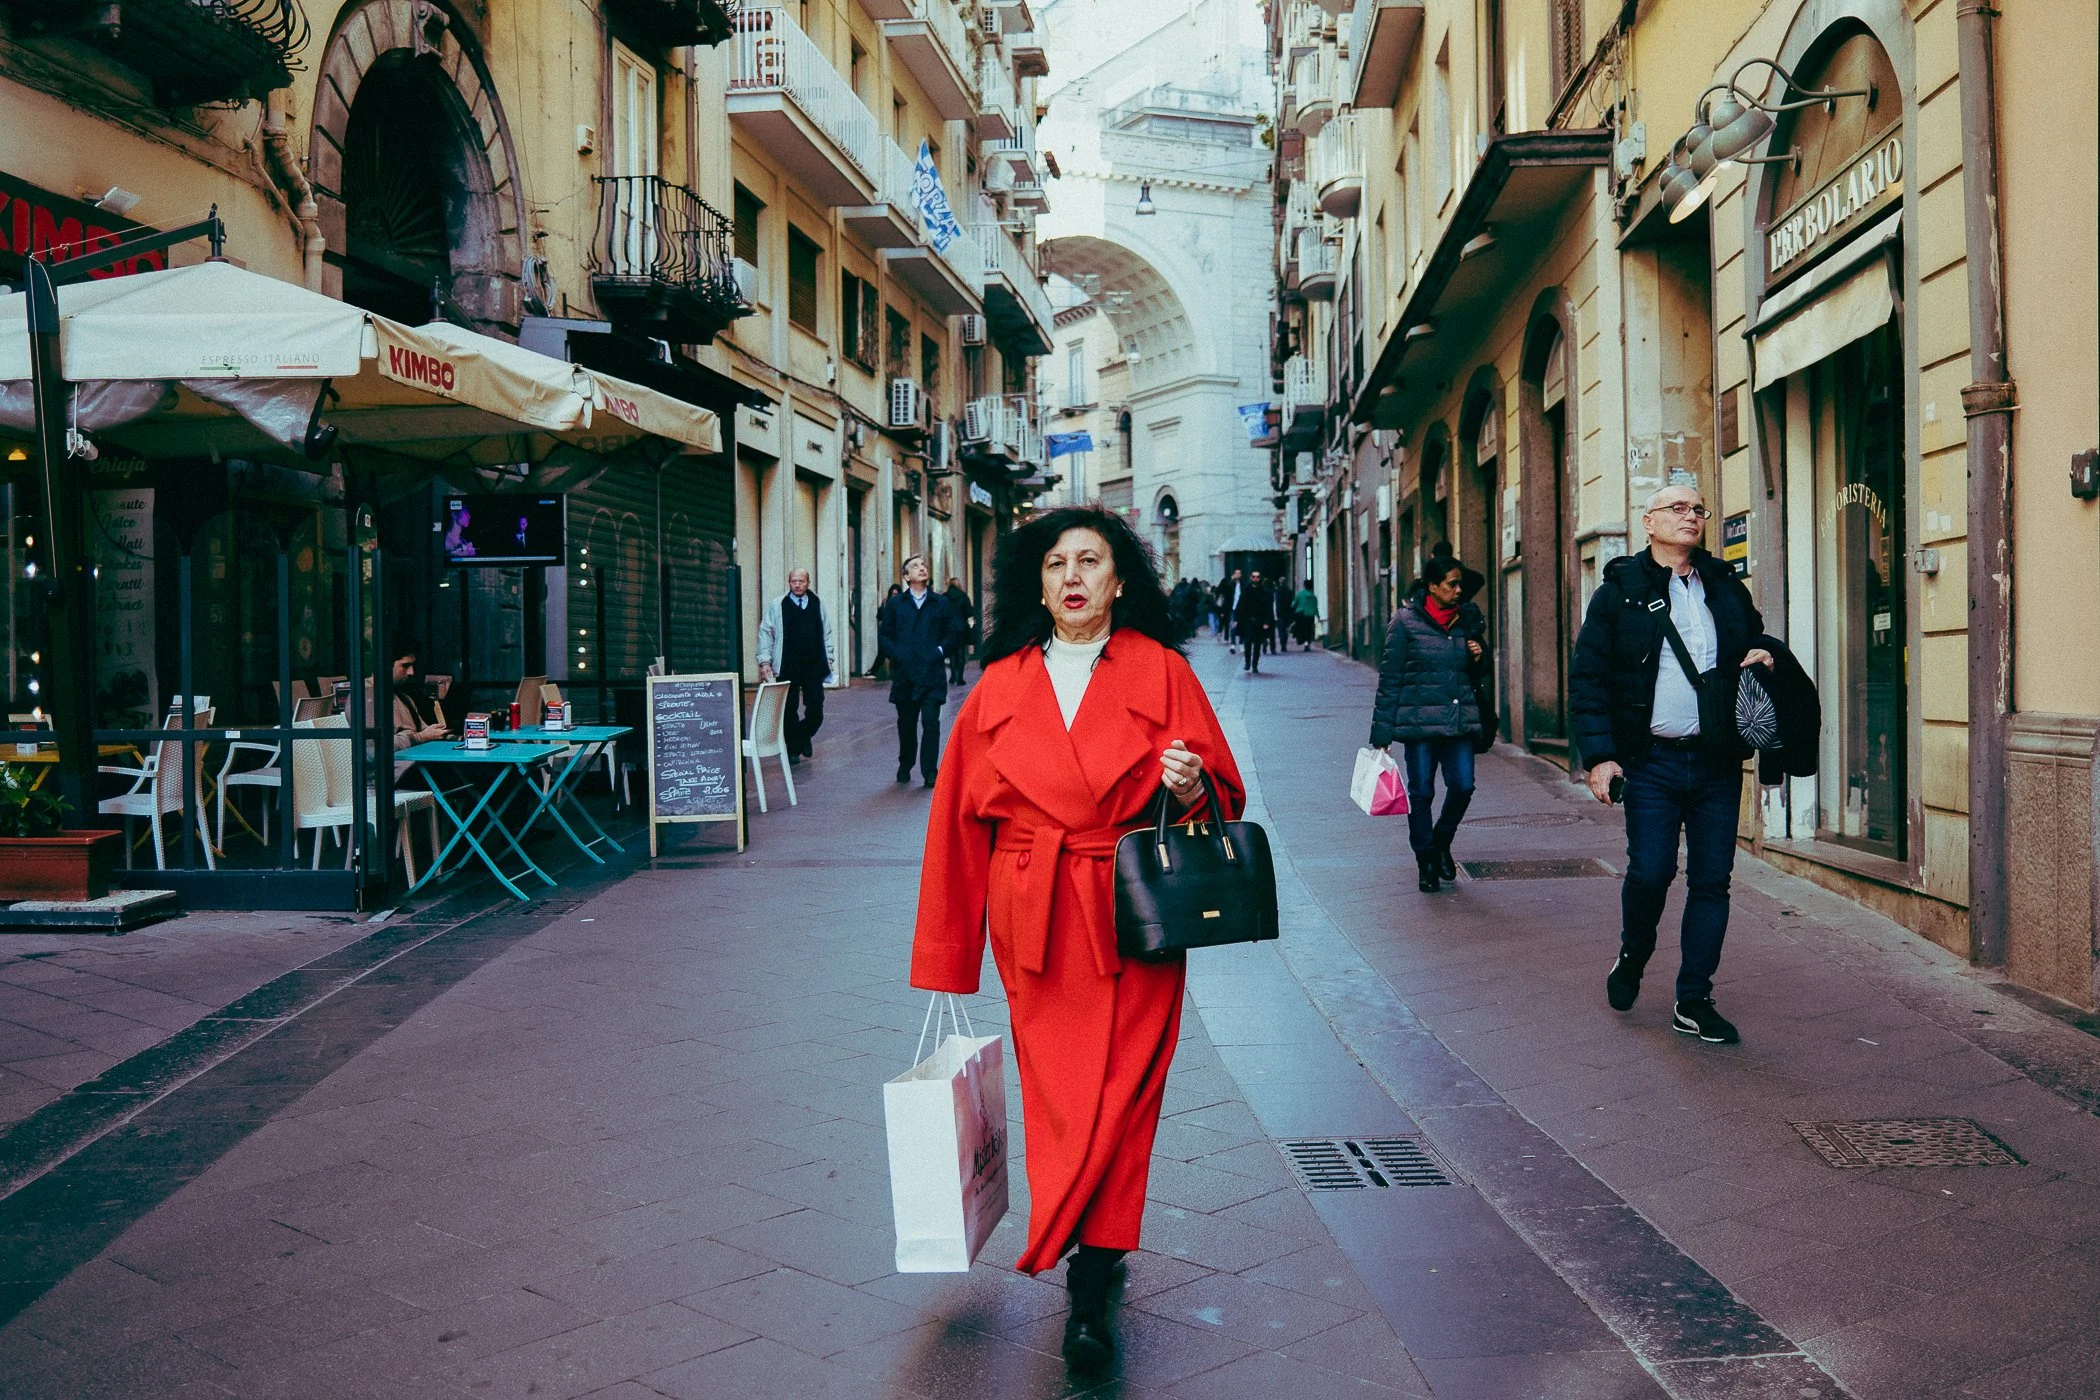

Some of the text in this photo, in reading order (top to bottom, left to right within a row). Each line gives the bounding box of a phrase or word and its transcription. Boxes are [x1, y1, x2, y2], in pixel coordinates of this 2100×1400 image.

[1771, 138, 1903, 273] L'ERBOLARIO
[201, 353, 320, 365] ESPRESSO ITALIANO
[389, 345, 455, 391] KIMBO
[696, 764, 721, 774] PRICE
